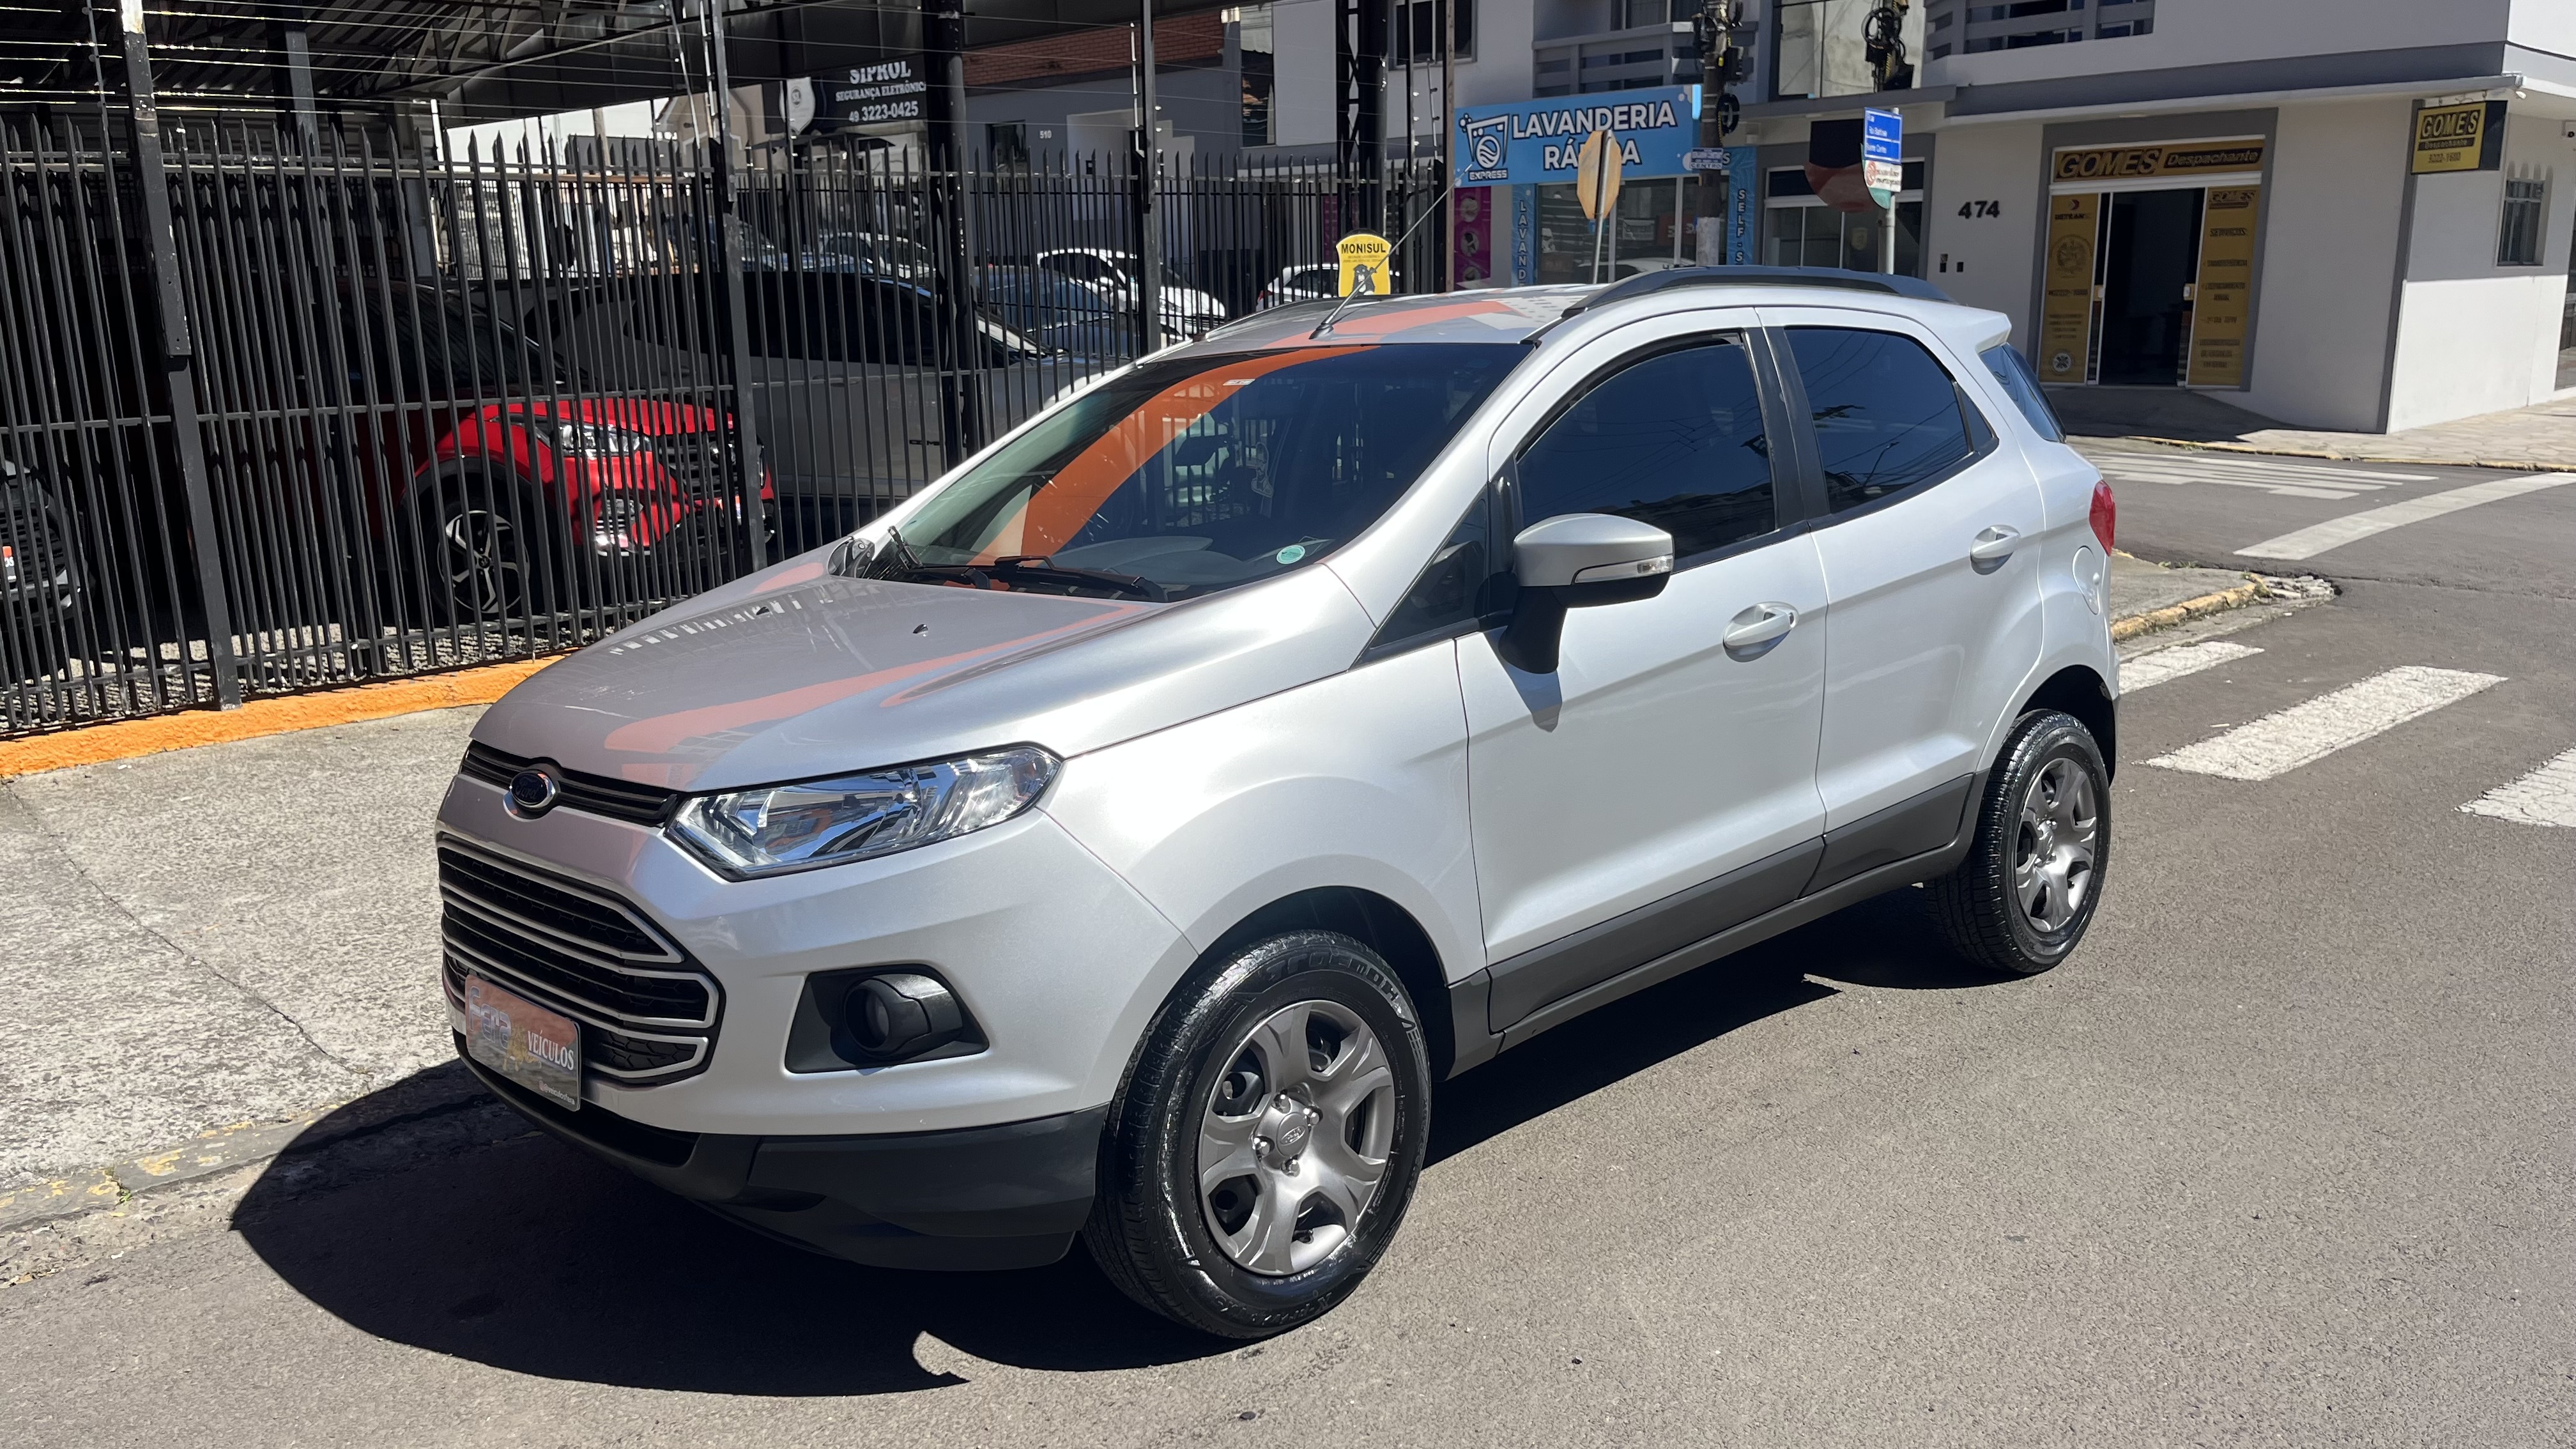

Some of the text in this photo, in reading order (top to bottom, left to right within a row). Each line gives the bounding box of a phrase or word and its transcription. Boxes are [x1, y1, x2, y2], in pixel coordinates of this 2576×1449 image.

[849, 61, 912, 84] SIPROL
[835, 86, 880, 102] SEGURANÇA
[848, 100, 919, 123] 49 3223-0425
[1512, 100, 1677, 139] LAVANDERIA
[1039, 129, 1052, 139] 510
[2421, 111, 2478, 138] GOMES
[1469, 169, 1508, 181] EXPRESS
[2058, 149, 2259, 178] GOMES Despachante
[1958, 200, 2000, 219] 474
[1341, 243, 1386, 254] MONISUL
[1518, 199, 1528, 286] LAVAND
[527, 1030, 575, 1071] VEÍCULOS
